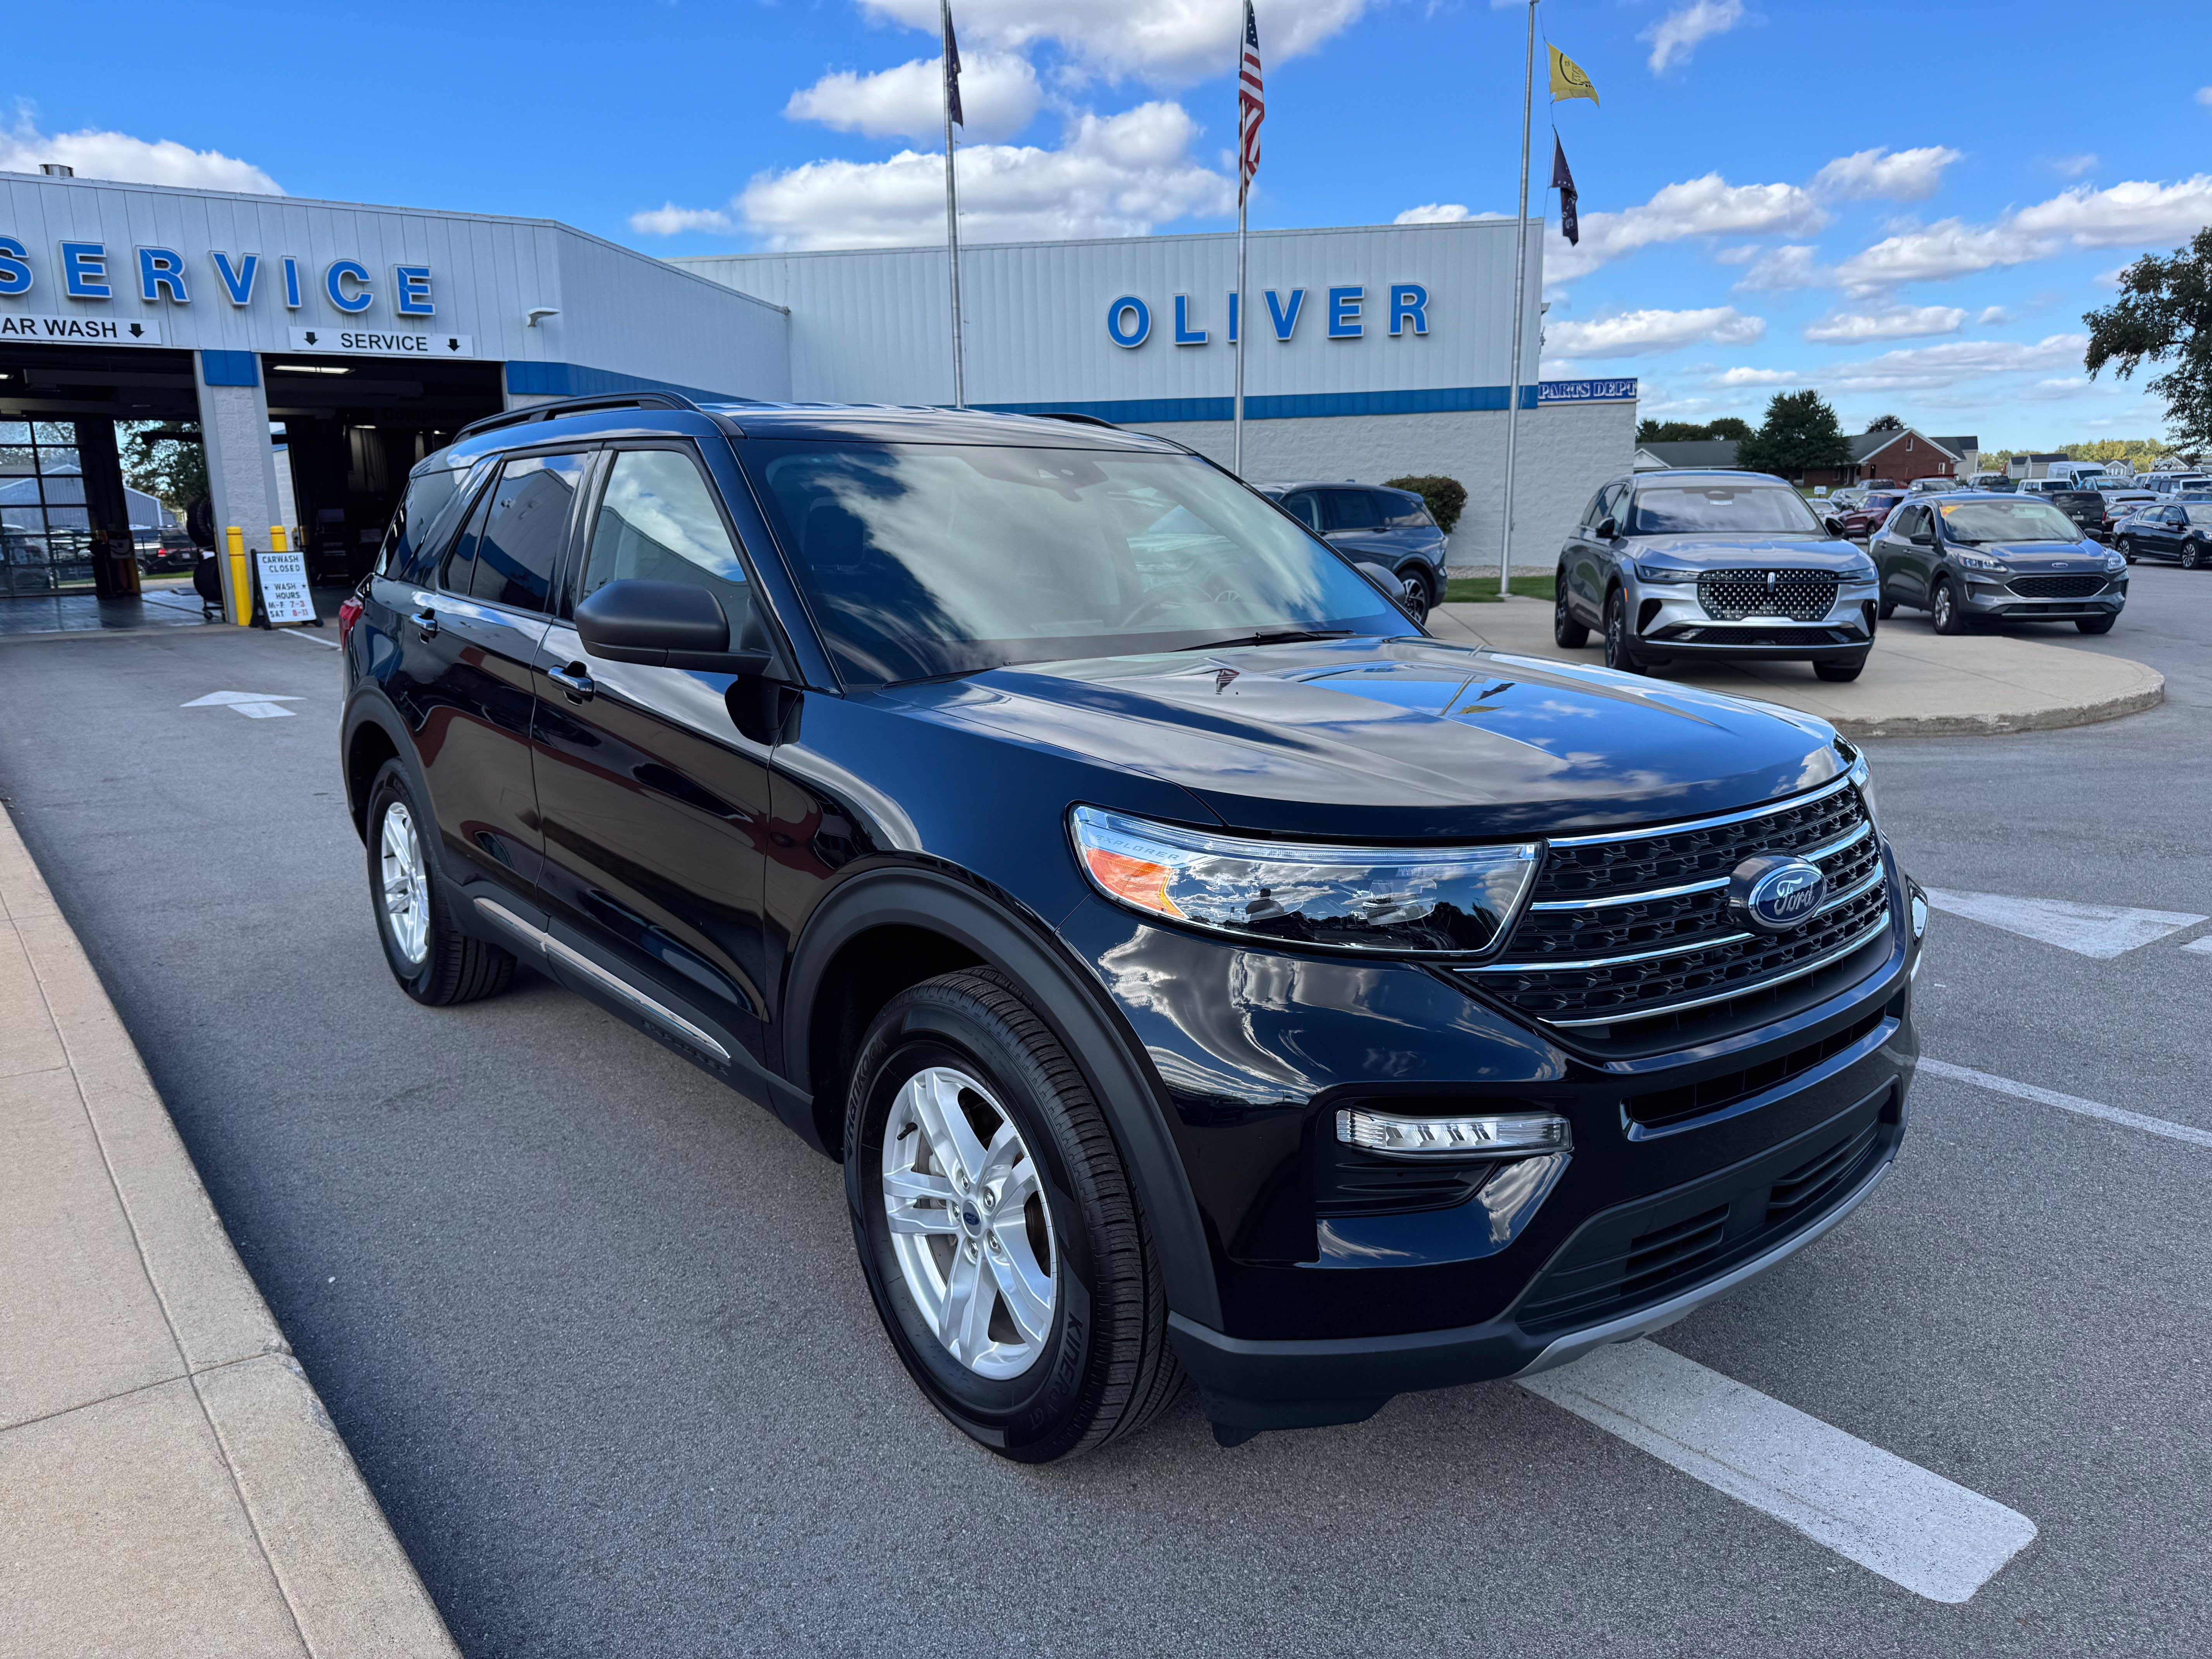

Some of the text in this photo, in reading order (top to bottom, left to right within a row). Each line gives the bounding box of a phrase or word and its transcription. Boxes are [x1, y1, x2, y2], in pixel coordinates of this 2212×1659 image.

[0, 235, 435, 317] SERVICE
[1106, 282, 1429, 349] OLIVER
[1, 318, 117, 338] AR WASH
[341, 333, 428, 351] SERVICE
[1538, 381, 1637, 399] PARTS DEPT
[262, 555, 298, 563] CARWASH
[269, 564, 300, 572] CLOSED
[270, 610, 284, 618] SAT
[1096, 835, 1180, 860] EXPLORER
[1774, 877, 1815, 915] Ford
[641, 1019, 728, 1076] EXPLORER
